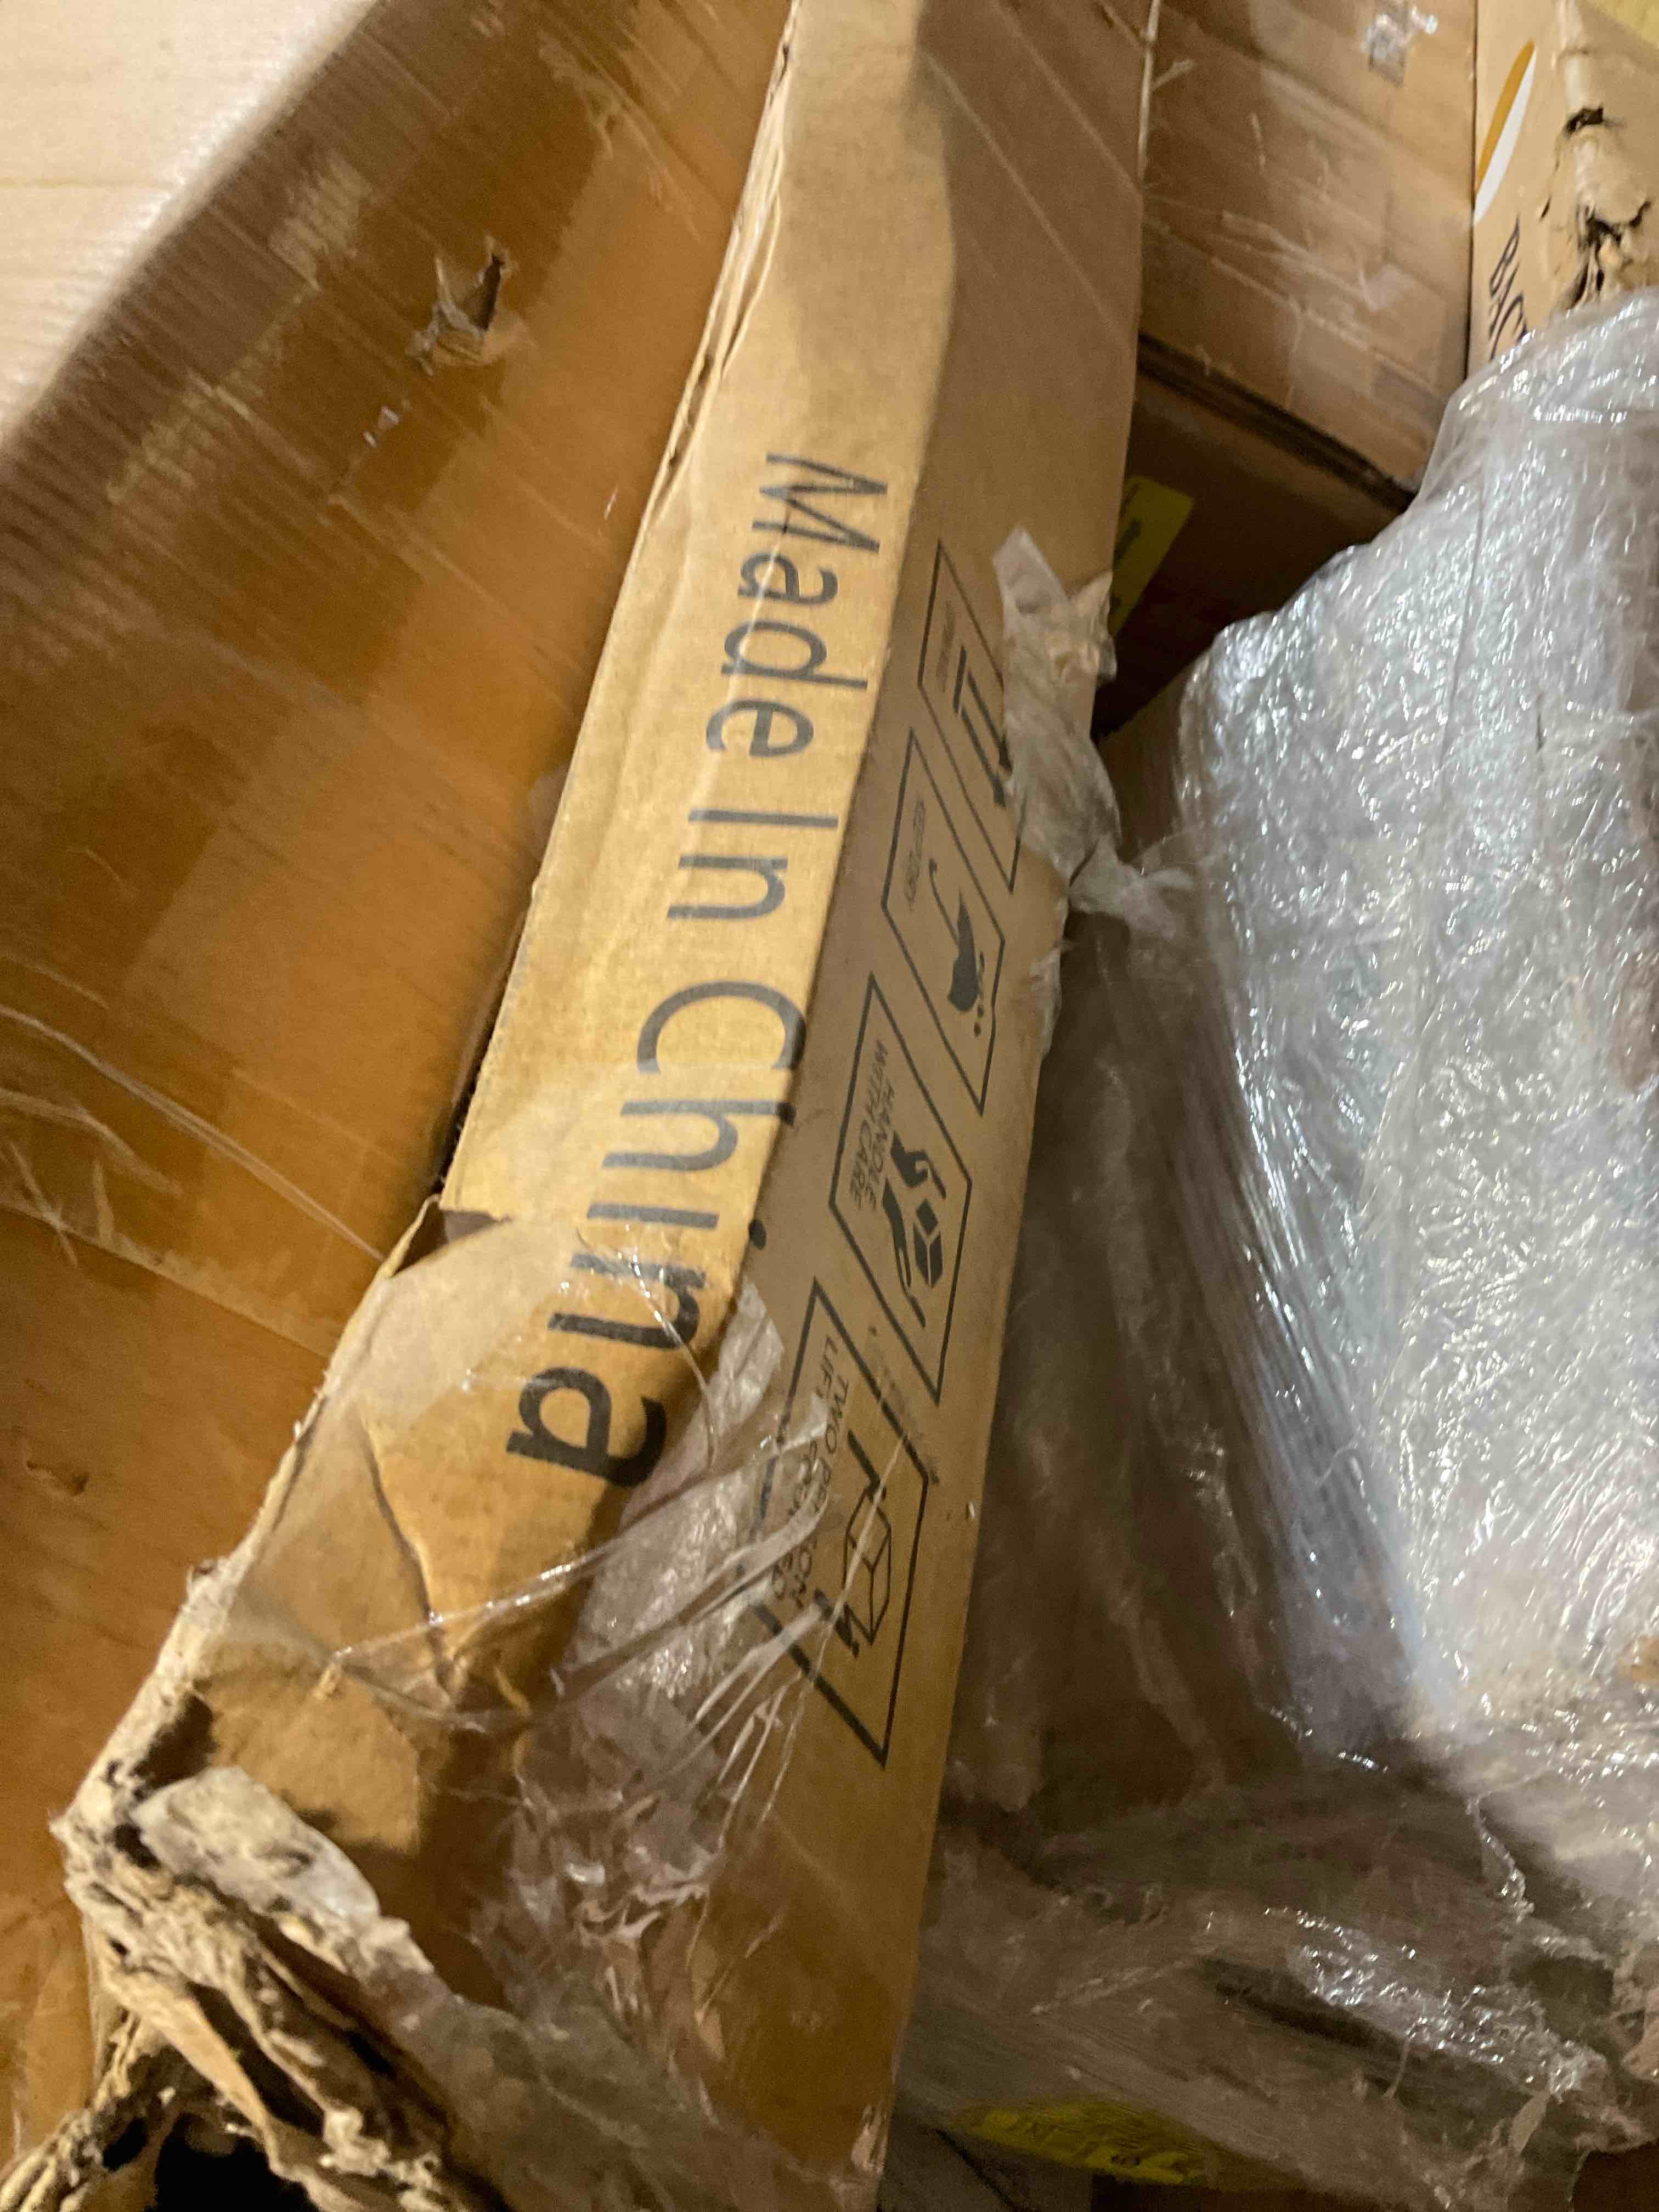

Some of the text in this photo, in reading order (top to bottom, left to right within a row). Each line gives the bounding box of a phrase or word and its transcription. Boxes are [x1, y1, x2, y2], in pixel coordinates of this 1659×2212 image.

[506, 451, 889, 1489] Made In China
[850, 1039, 888, 1210] WITH CARE
[866, 1076, 895, 1210] HANDLE
[824, 1375, 849, 1454] TWO
